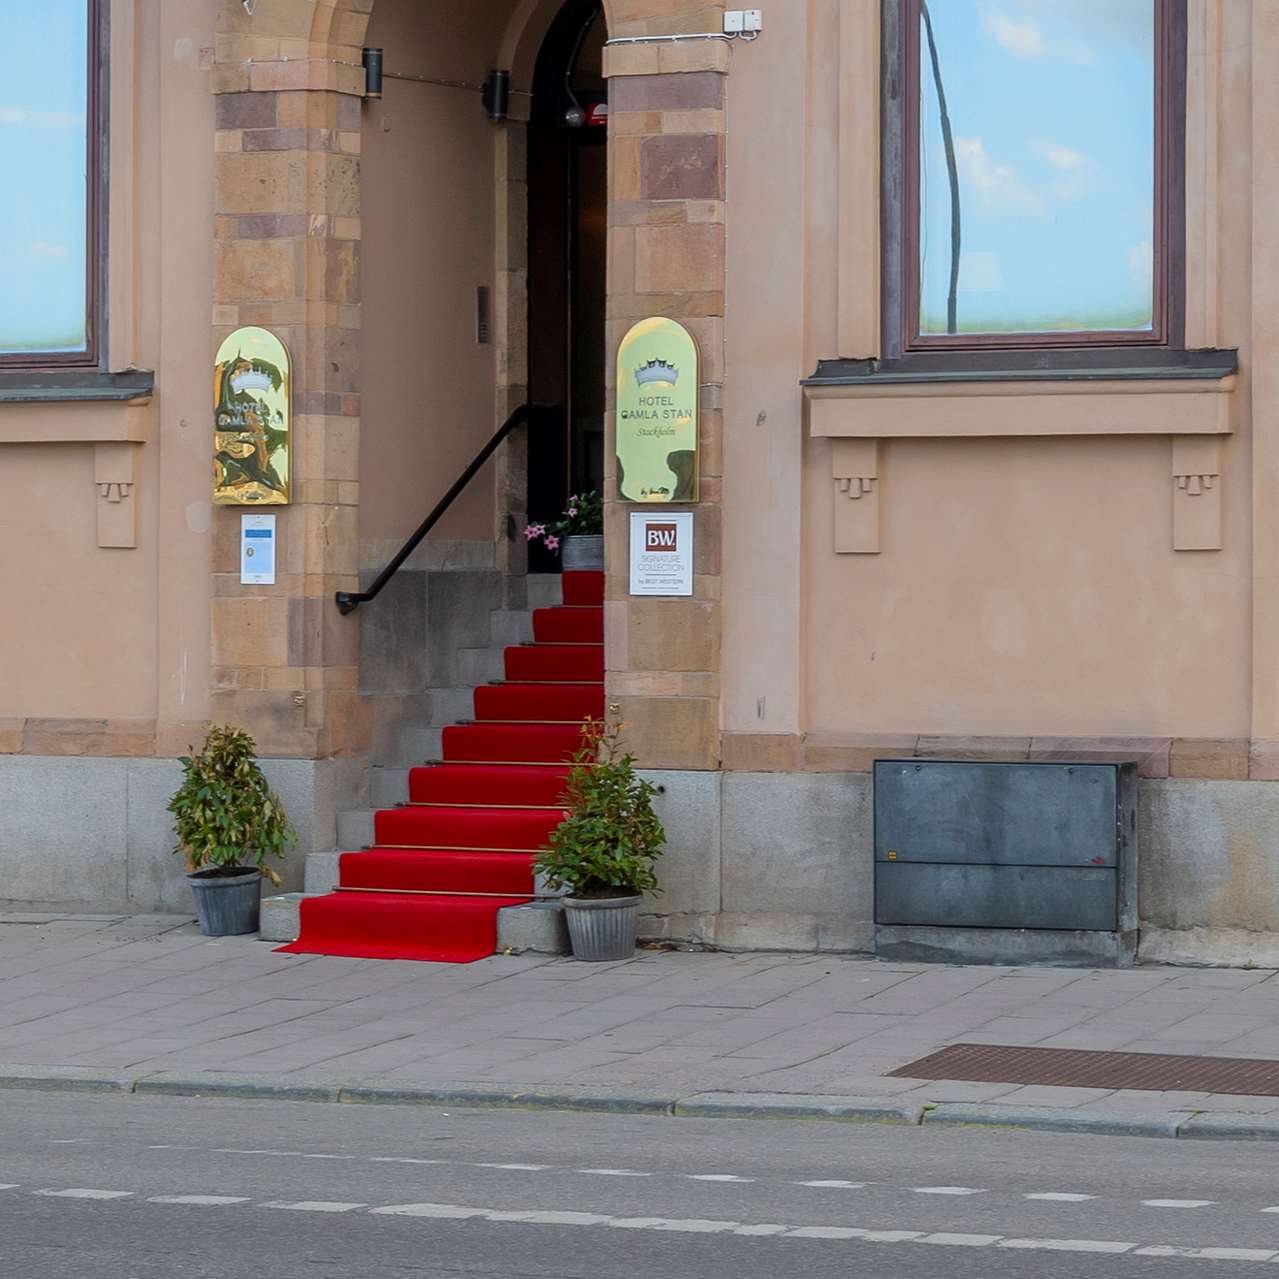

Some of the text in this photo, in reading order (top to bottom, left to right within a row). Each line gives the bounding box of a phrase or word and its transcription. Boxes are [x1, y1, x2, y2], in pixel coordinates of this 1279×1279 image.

[639, 396, 674, 406] HOTEL
[621, 409, 692, 419] GAMLA STAN
